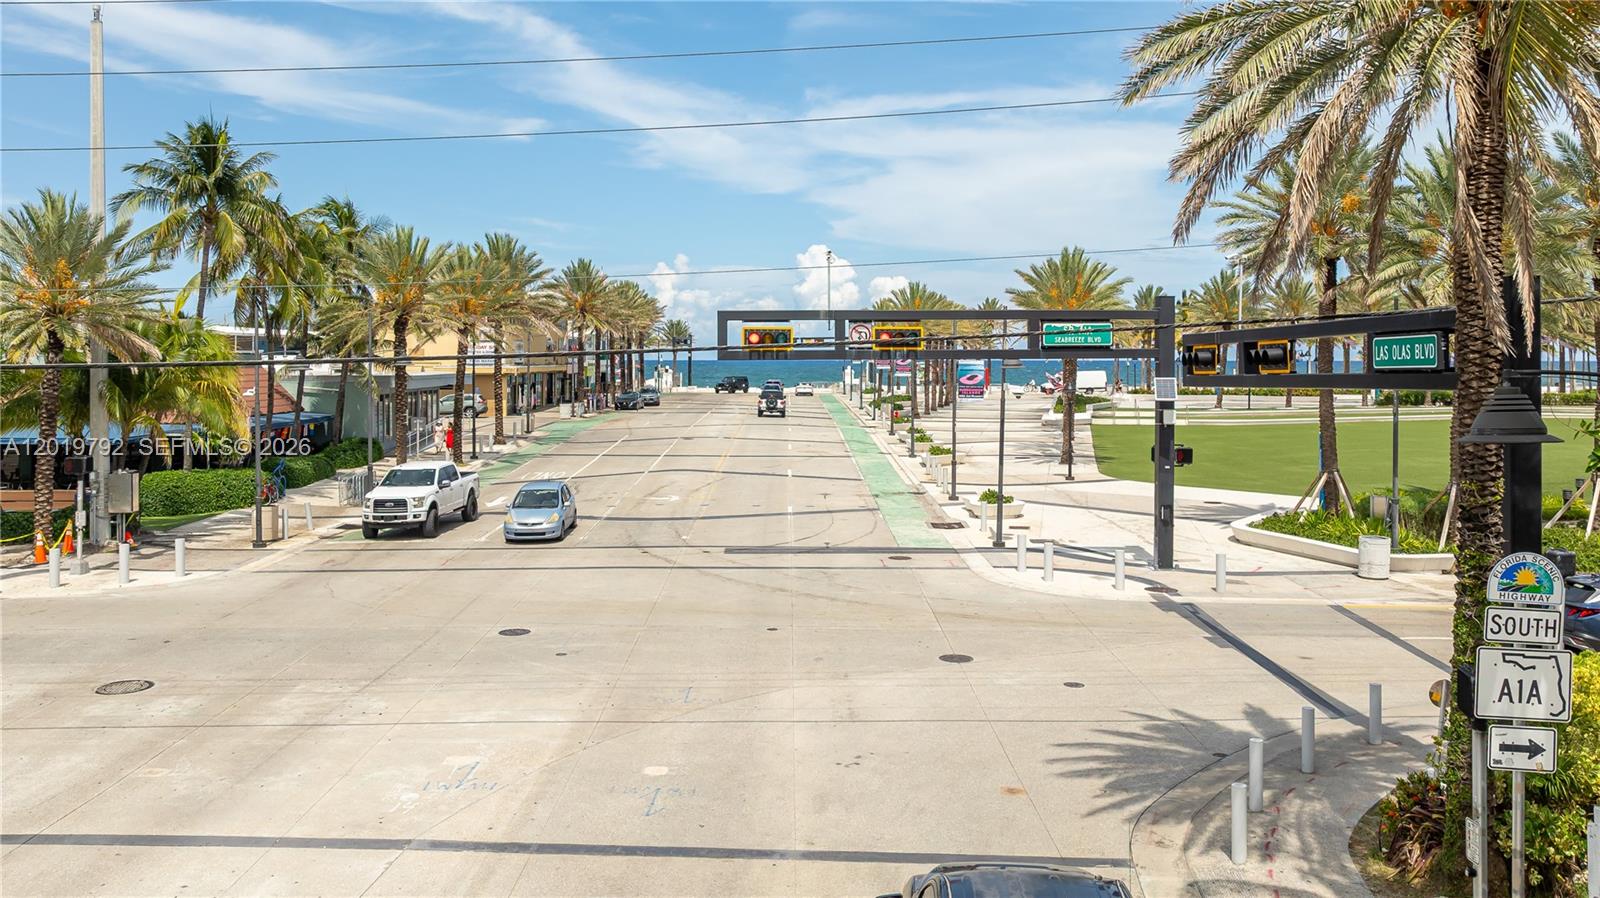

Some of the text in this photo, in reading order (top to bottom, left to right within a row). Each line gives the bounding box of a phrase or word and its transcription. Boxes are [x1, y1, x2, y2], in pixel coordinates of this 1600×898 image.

[1375, 343, 1435, 361] LAS OLAS BLVD
[1493, 555, 1560, 582] FLORIDA SCENIC
[1499, 592, 1551, 602] HIGHWAY
[1489, 614, 1557, 638] SOUTH
[1497, 678, 1542, 705] A1A
